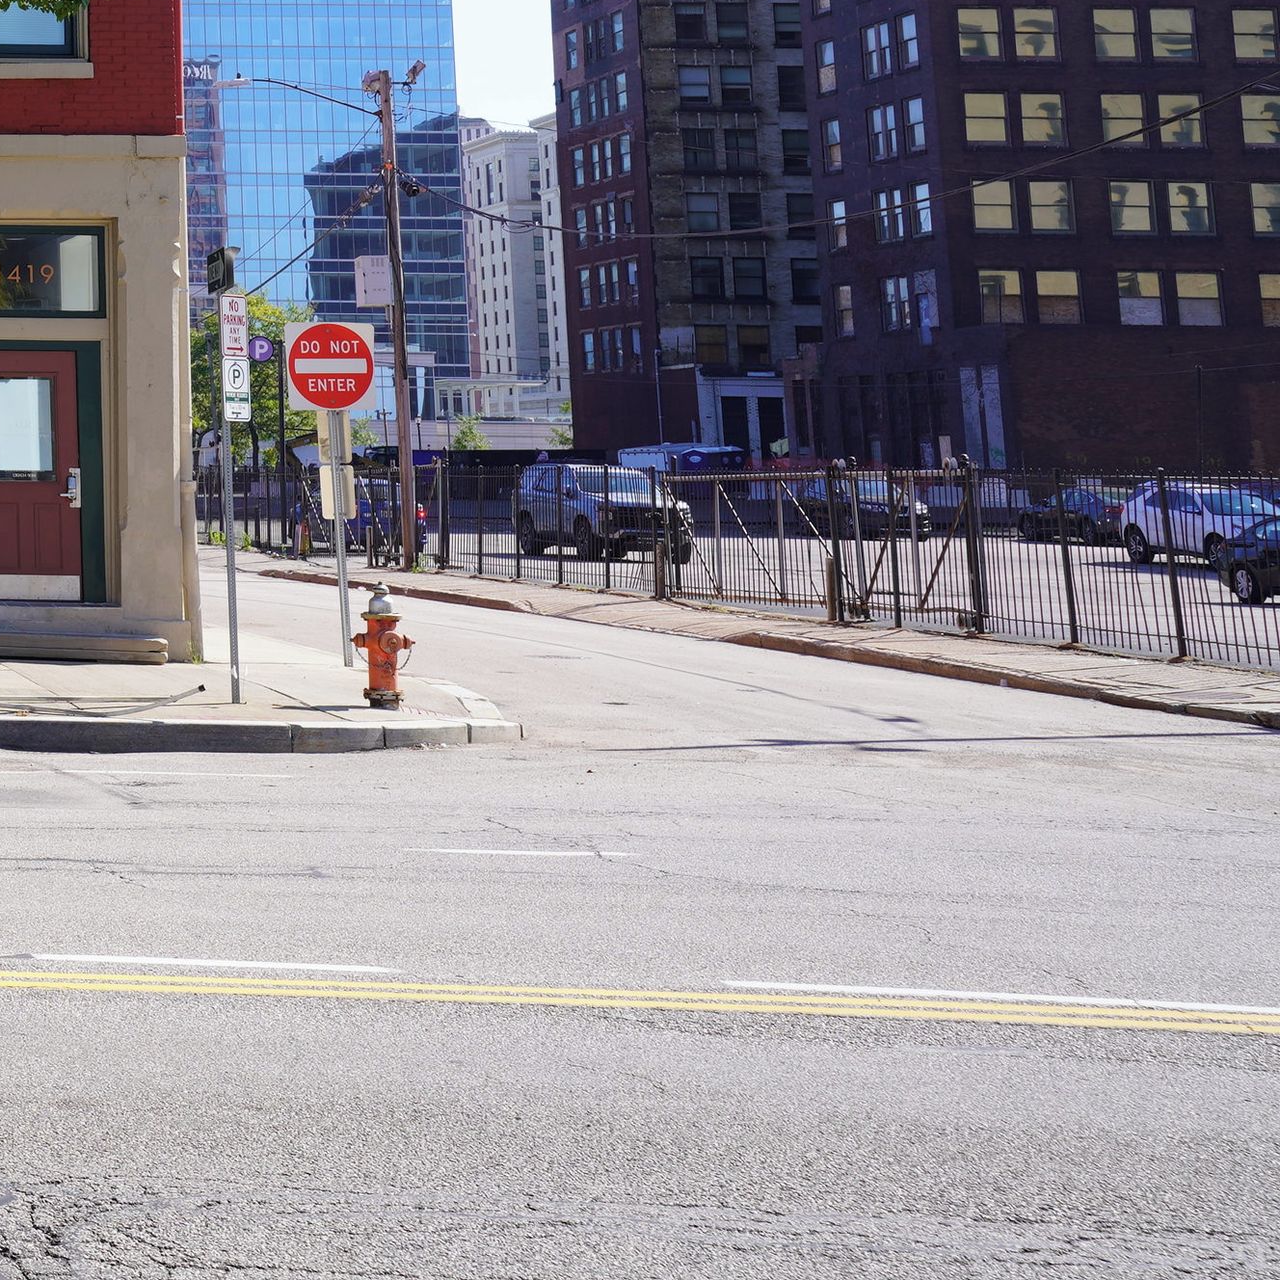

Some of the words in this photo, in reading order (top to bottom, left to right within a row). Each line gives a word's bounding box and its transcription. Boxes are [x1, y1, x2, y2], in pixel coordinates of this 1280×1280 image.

[228, 300, 239, 313] NO
[223, 314, 246, 327] PARKING
[229, 327, 240, 335] ANY
[228, 335, 241, 345] TIME
[300, 340, 321, 354] DO
[330, 340, 359, 354] NOT
[308, 378, 356, 392] ENTER
